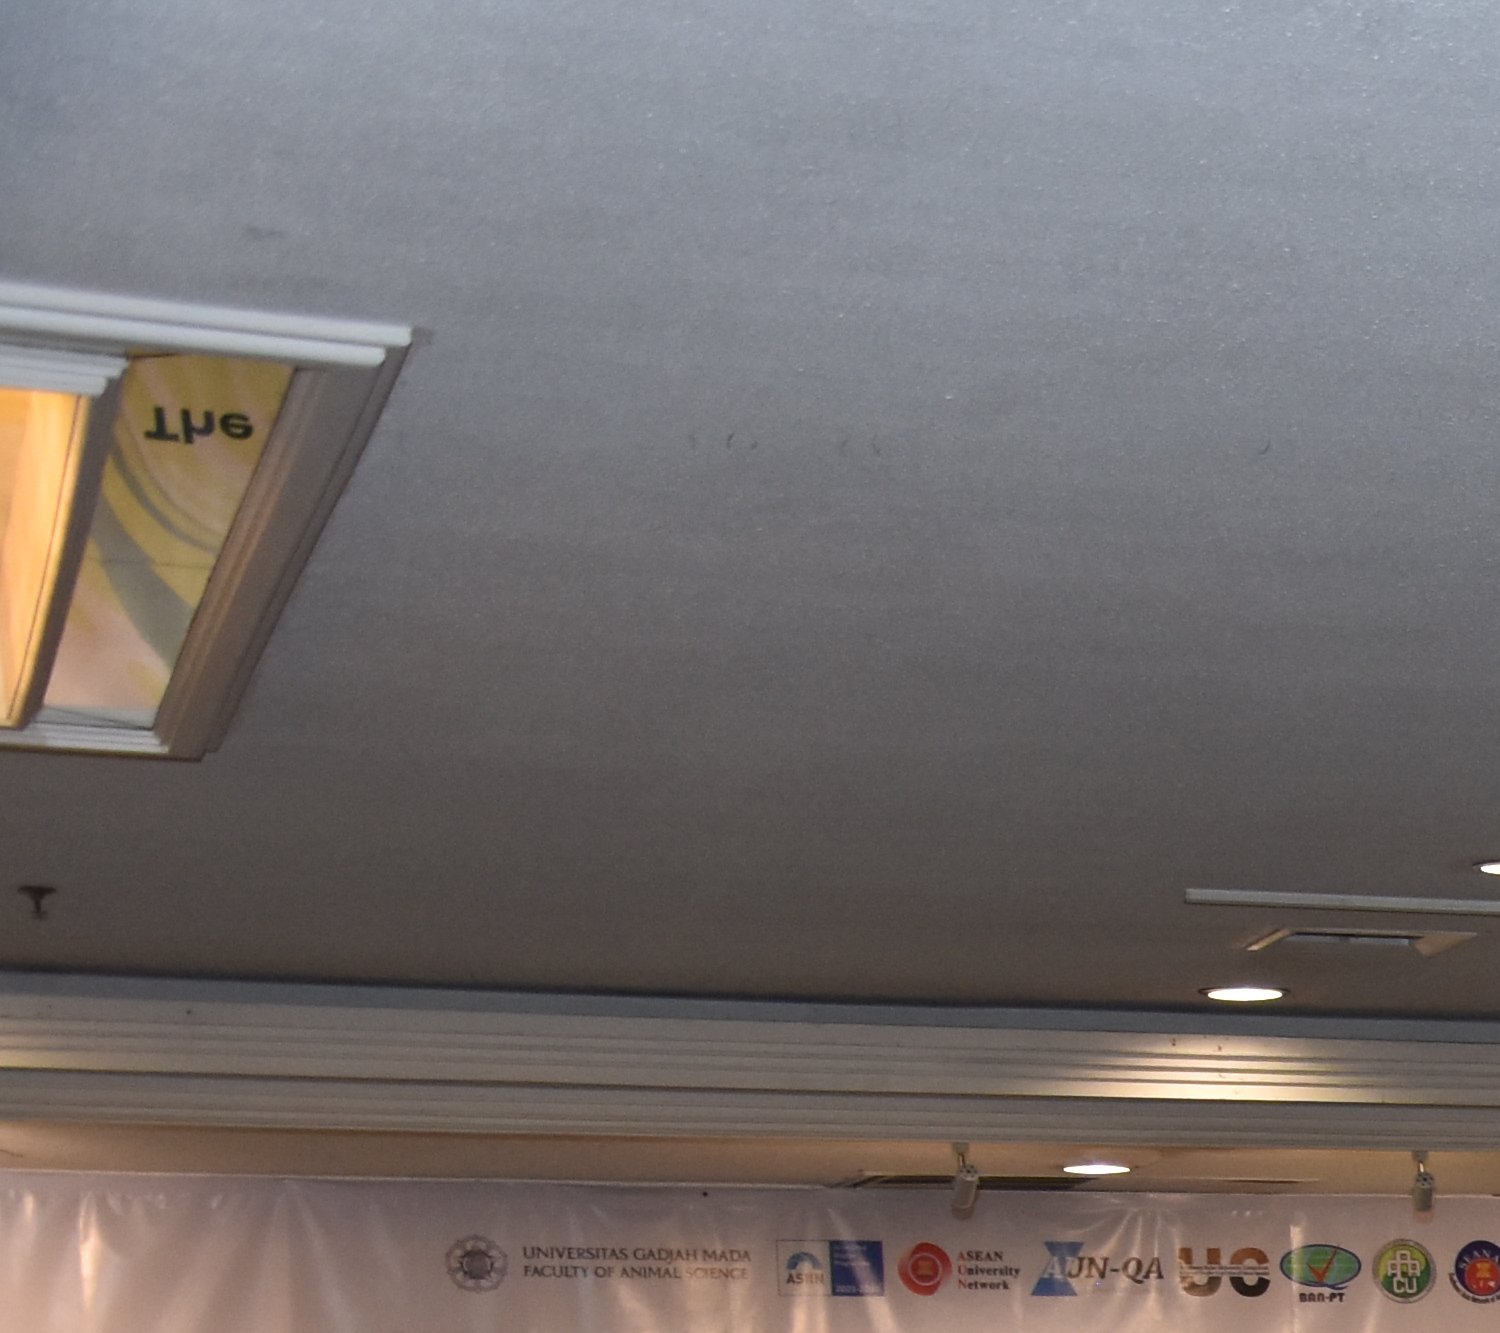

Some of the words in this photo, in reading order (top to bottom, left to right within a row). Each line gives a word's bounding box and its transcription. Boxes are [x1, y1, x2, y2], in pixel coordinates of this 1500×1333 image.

[523, 1247, 629, 1260] UNIVERSITAS
[633, 1247, 697, 1265] GADJAH
[702, 1249, 751, 1262] MADA
[957, 1251, 1003, 1262] ASEAN
[524, 1265, 590, 1278] FACULTY
[594, 1266, 615, 1278] OF
[620, 1266, 682, 1279] ANIMAL
[685, 1268, 749, 1279] SCIENCE
[957, 1265, 1021, 1278] University
[957, 1279, 1010, 1290] Network
[1299, 1292, 1346, 1304] BAN-PT
